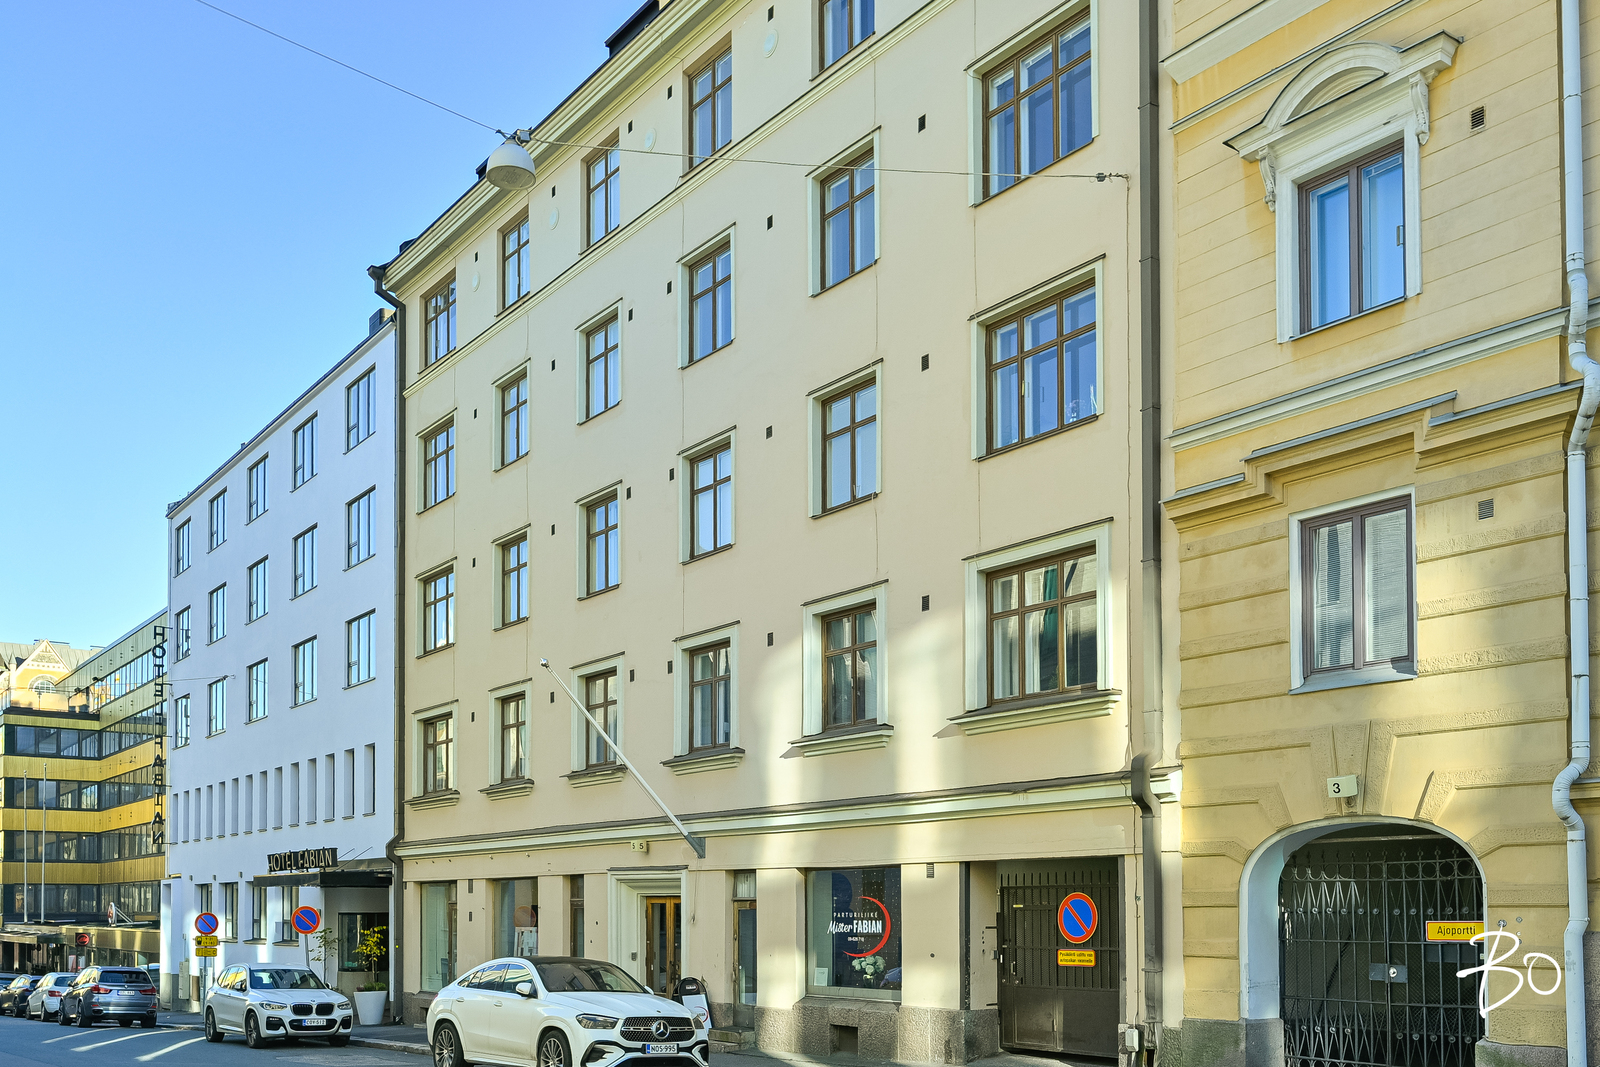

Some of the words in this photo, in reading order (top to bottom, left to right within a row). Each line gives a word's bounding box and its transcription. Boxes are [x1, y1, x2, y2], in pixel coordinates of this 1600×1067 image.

[1332, 782, 1341, 794] 3
[268, 852, 297, 872] HOTEL
[298, 848, 332, 869] FABIAN
[827, 920, 853, 935] Mister
[853, 920, 882, 934] FABIAN
[1437, 926, 1476, 936] Ajoportti
